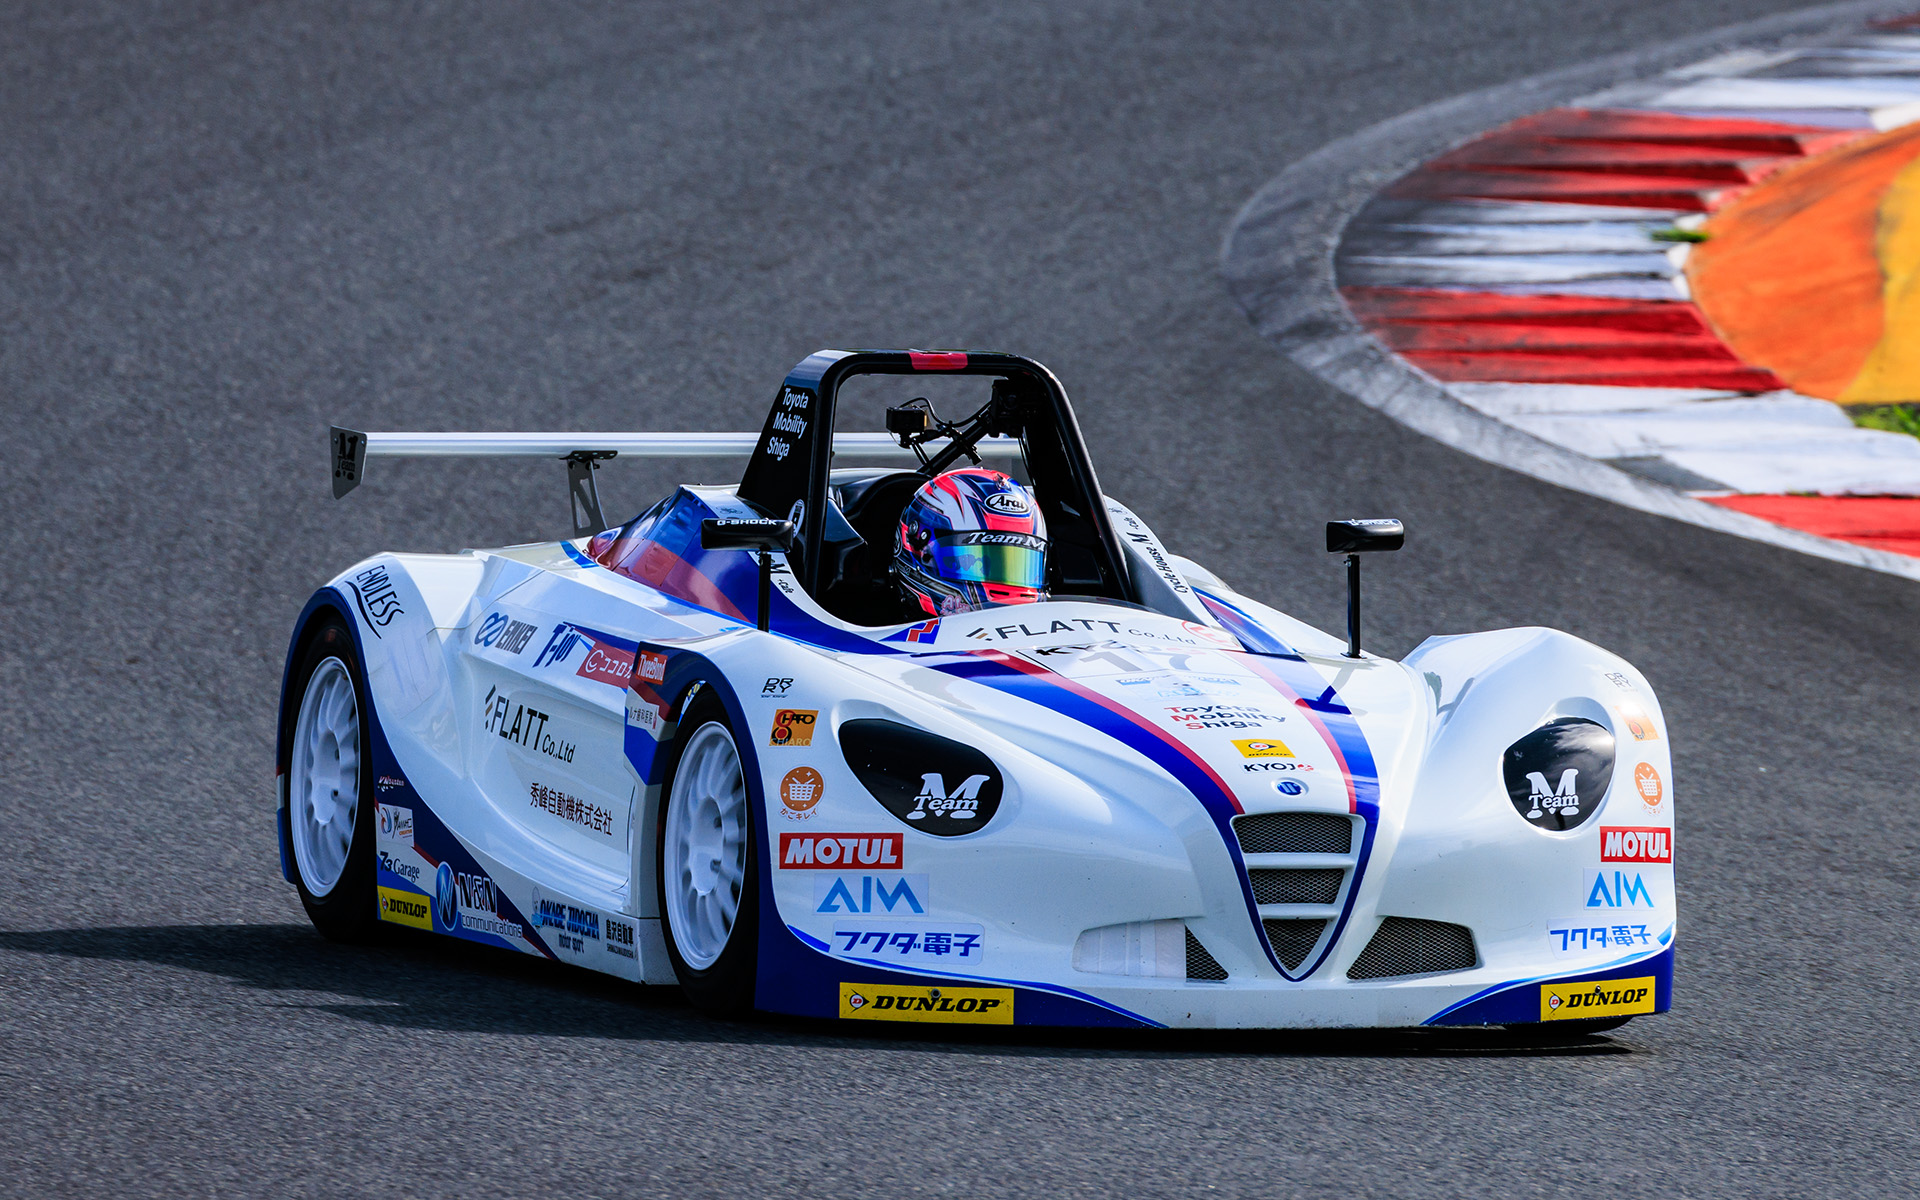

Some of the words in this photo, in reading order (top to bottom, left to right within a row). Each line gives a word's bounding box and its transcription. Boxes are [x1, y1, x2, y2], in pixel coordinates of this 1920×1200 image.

[782, 388, 809, 411] Toyota
[772, 411, 807, 439] Mobility
[766, 437, 790, 461] Shiga
[968, 531, 1021, 545] Team
[1022, 539, 1047, 551] M
[355, 564, 405, 626] ENDLESS
[494, 620, 538, 655] ENKEI
[994, 618, 1120, 640] FLATT
[637, 653, 667, 681] ThreeBond
[1164, 705, 1261, 713] Toyota
[1170, 711, 1286, 722] Mobility
[490, 695, 549, 750] FLATT
[1185, 720, 1262, 730] Shiga
[906, 772, 990, 820] M
[914, 794, 978, 811] Team
[1526, 768, 1579, 819] M
[1529, 793, 1579, 809] Team
[784, 838, 898, 864] MOTUL
[1604, 831, 1669, 858] MOTUL
[393, 858, 420, 883] Garage
[816, 876, 924, 914] AIM
[1586, 871, 1655, 908] AIM
[390, 898, 427, 918] DUNLOP
[461, 913, 523, 938] communications
[1550, 924, 1652, 951] フクダ電子
[835, 931, 981, 957] フクダ電子
[871, 995, 1000, 1013] DUNLOP
[1566, 988, 1648, 1009] DUNLOP
